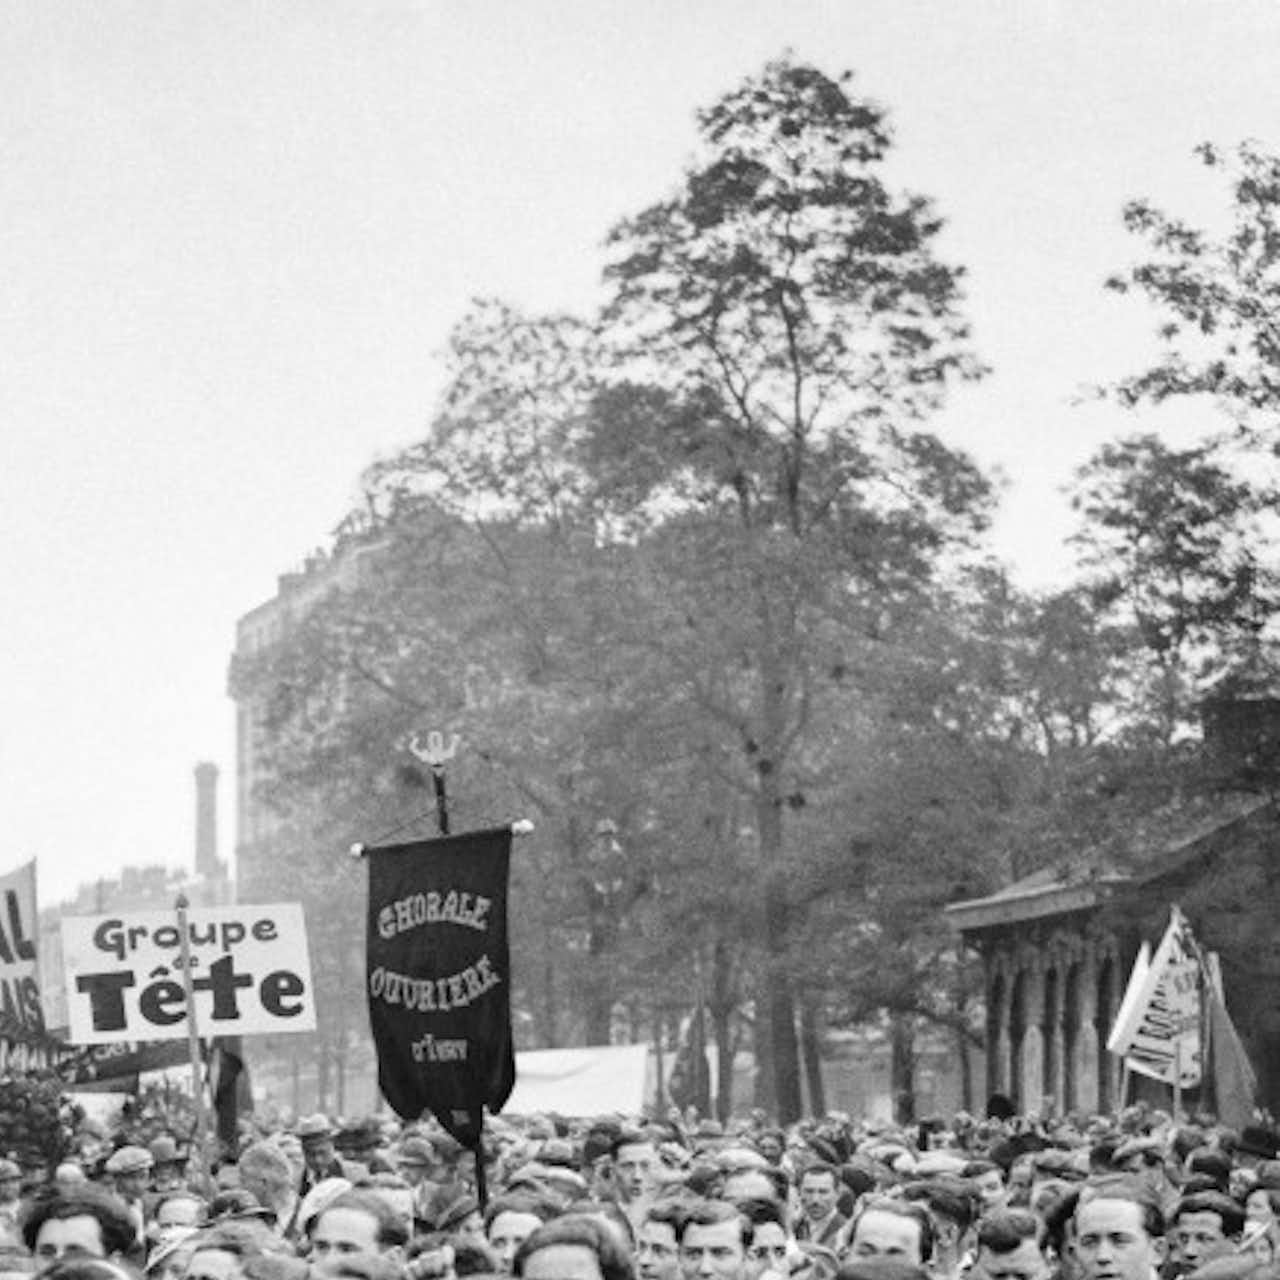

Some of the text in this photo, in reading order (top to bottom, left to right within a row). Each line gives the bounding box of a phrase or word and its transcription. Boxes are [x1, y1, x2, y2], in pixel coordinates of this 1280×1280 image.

[377, 890, 491, 939] CHORALE
[93, 919, 279, 961] Groupe
[75, 954, 305, 1032] Tête
